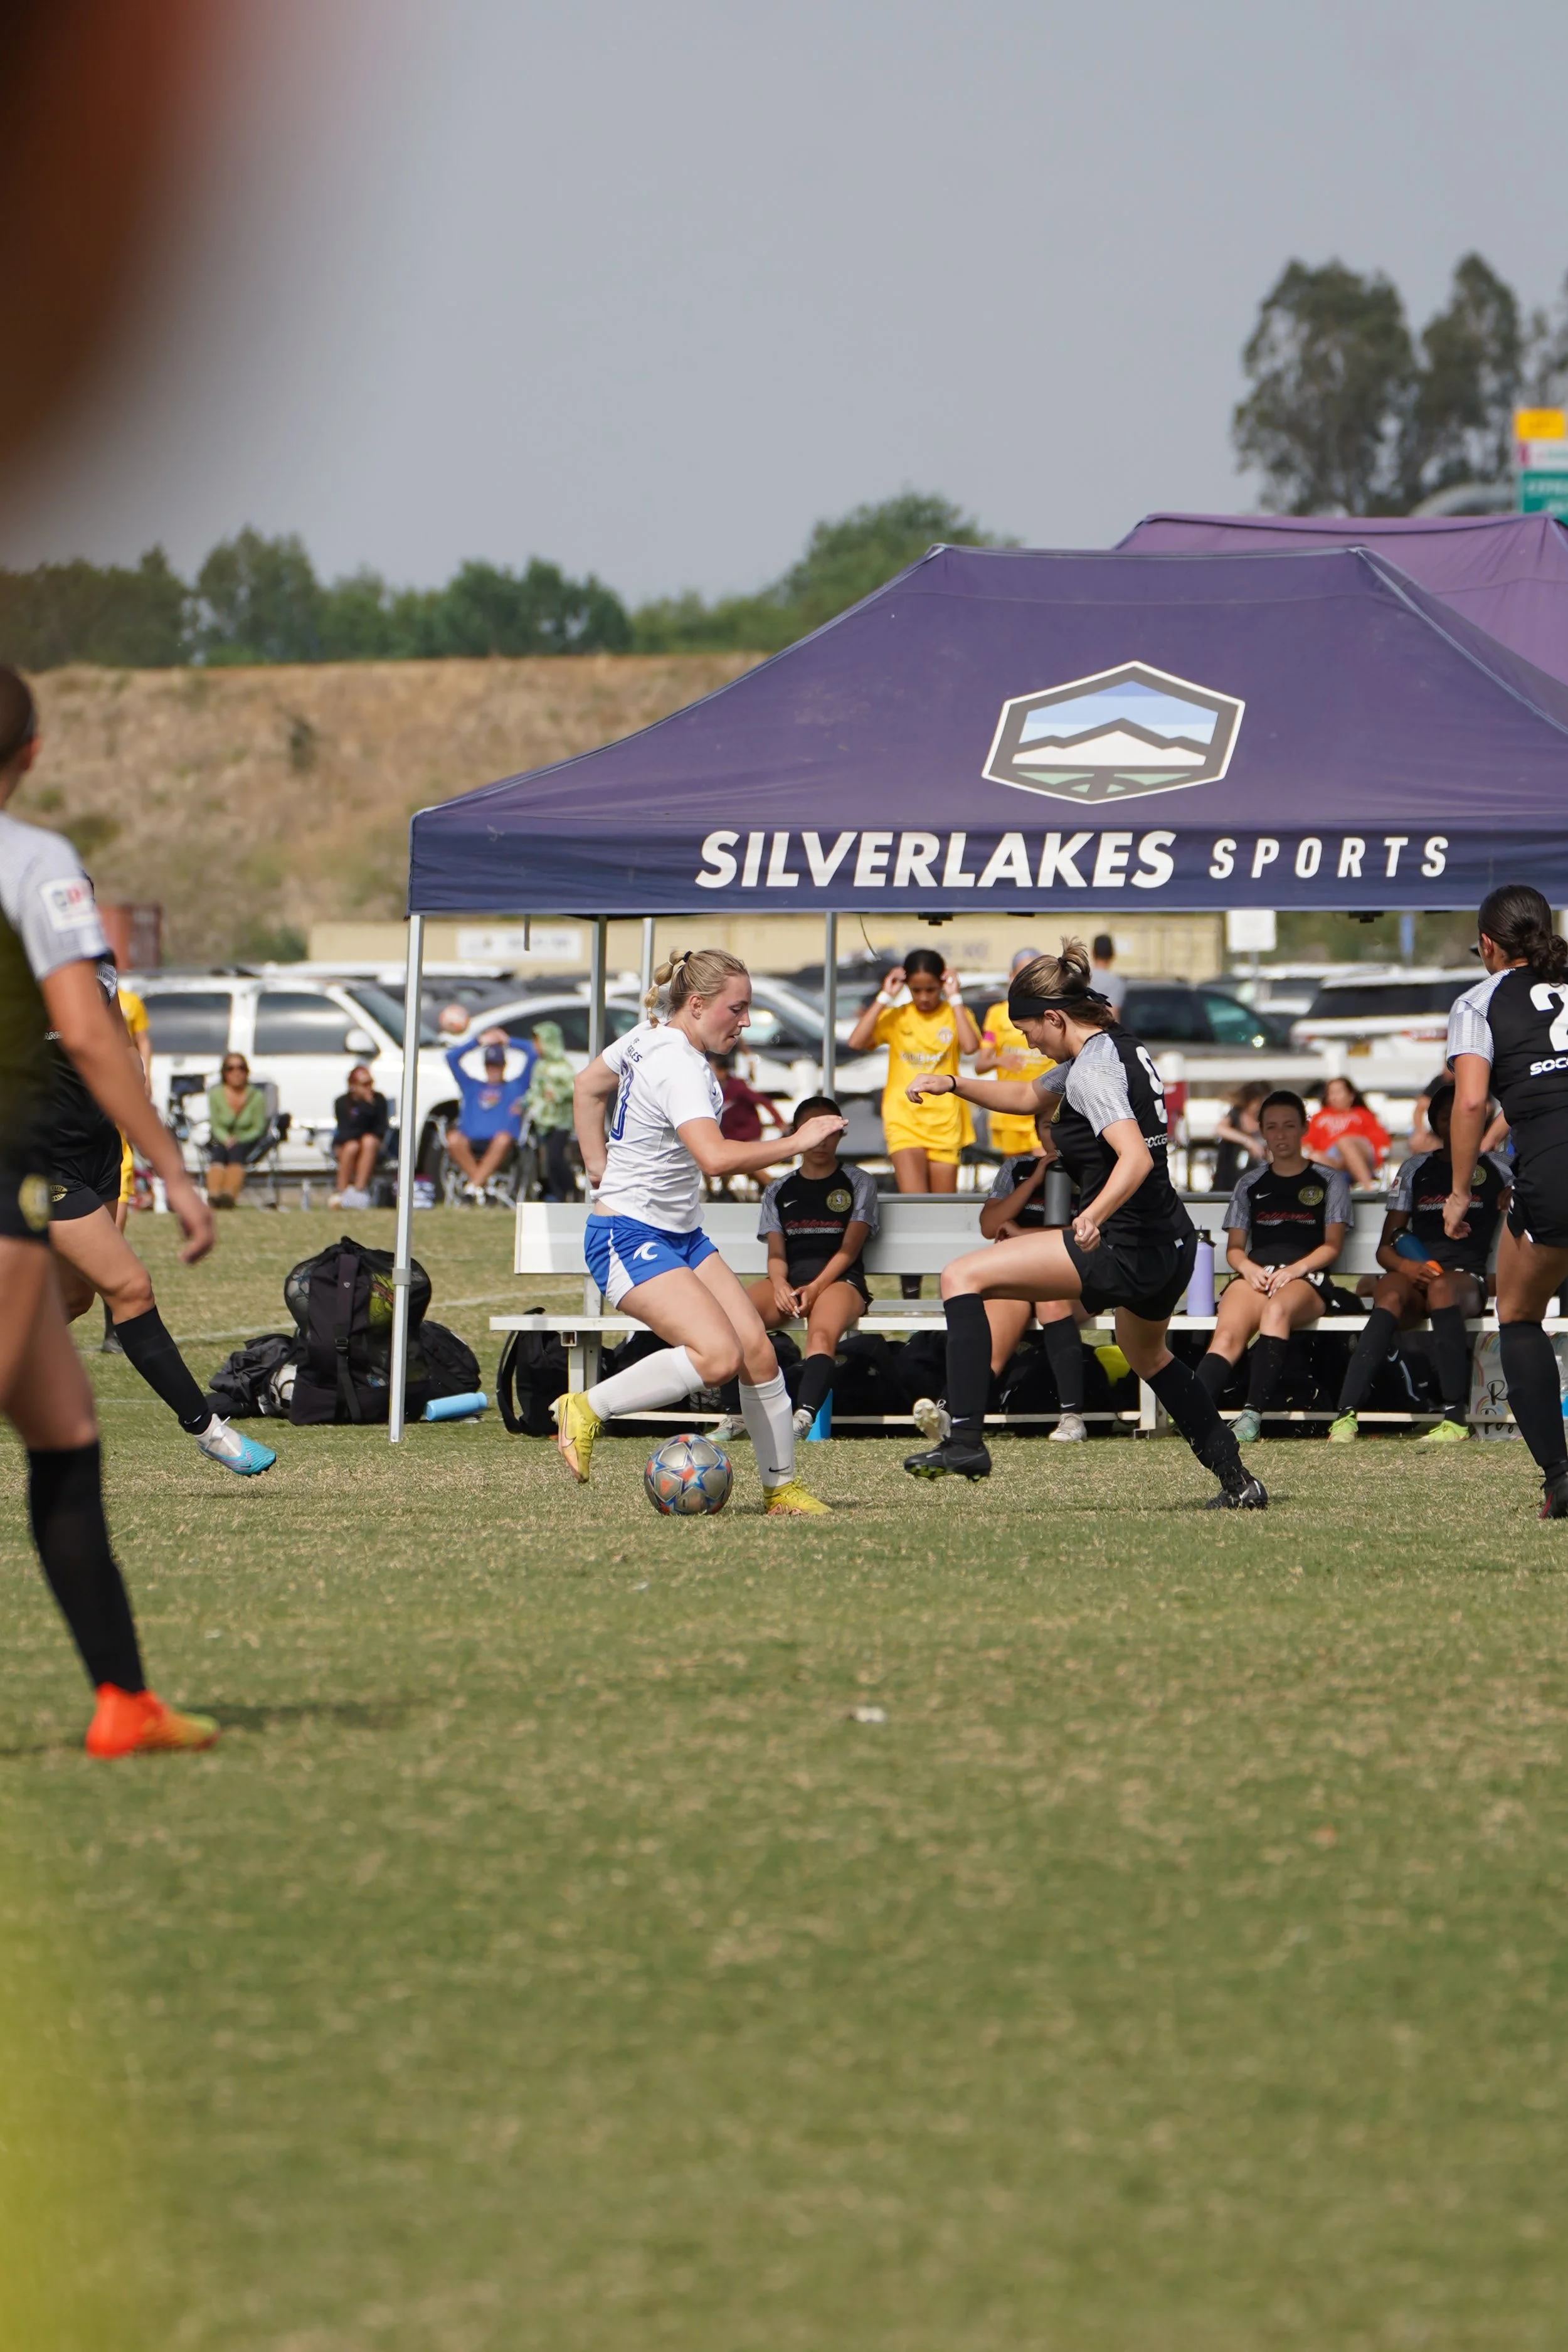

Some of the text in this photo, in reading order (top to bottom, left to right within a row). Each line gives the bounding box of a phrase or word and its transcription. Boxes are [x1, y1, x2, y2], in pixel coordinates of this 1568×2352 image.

[694, 830, 1449, 889] SILVERLAKES SPORTS
[1530, 982, 1568, 1052] 2
[1530, 1057, 1568, 1076] SOC
